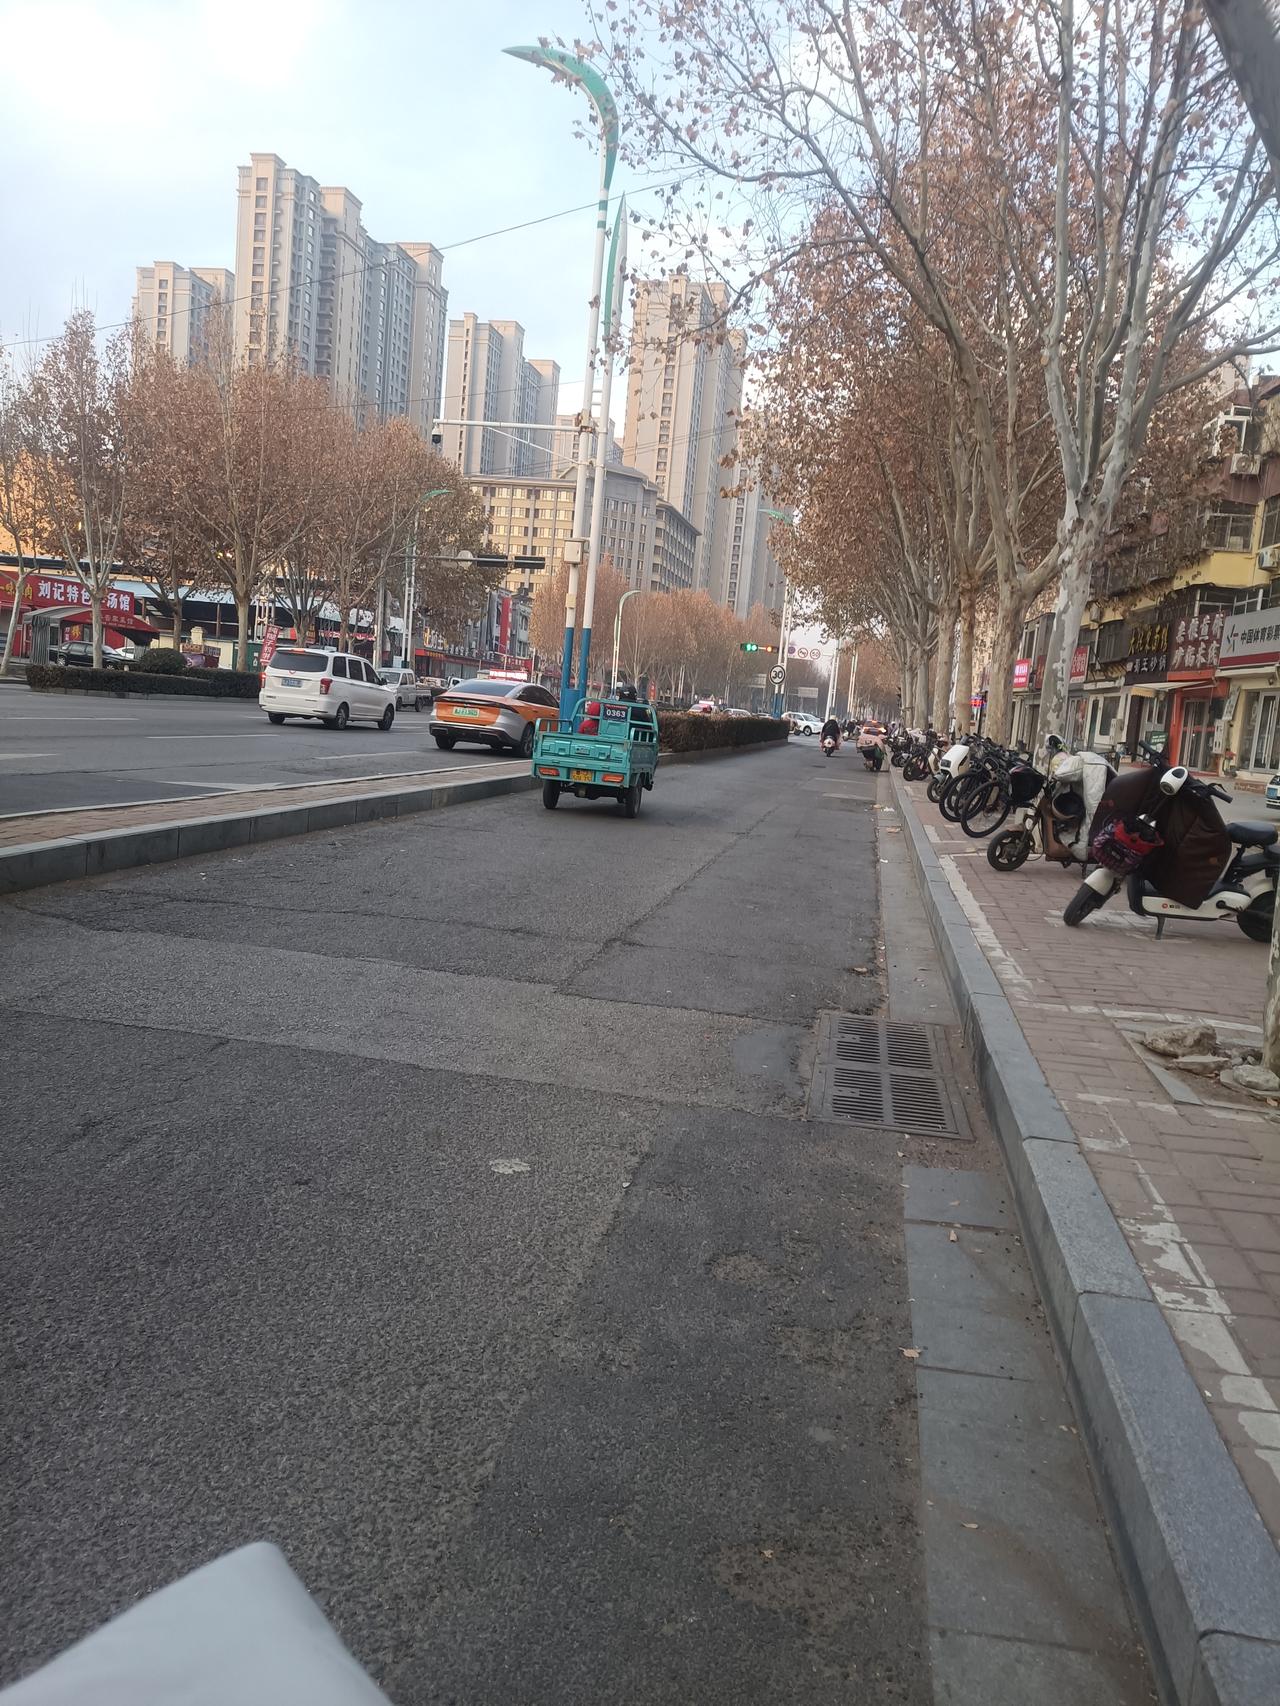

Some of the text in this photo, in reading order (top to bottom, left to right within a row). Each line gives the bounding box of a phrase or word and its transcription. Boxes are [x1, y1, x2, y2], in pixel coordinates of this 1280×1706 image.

[38, 580, 131, 611] 刘记特色汤馆
[772, 671, 783, 679] 30
[606, 709, 626, 718] 0363
